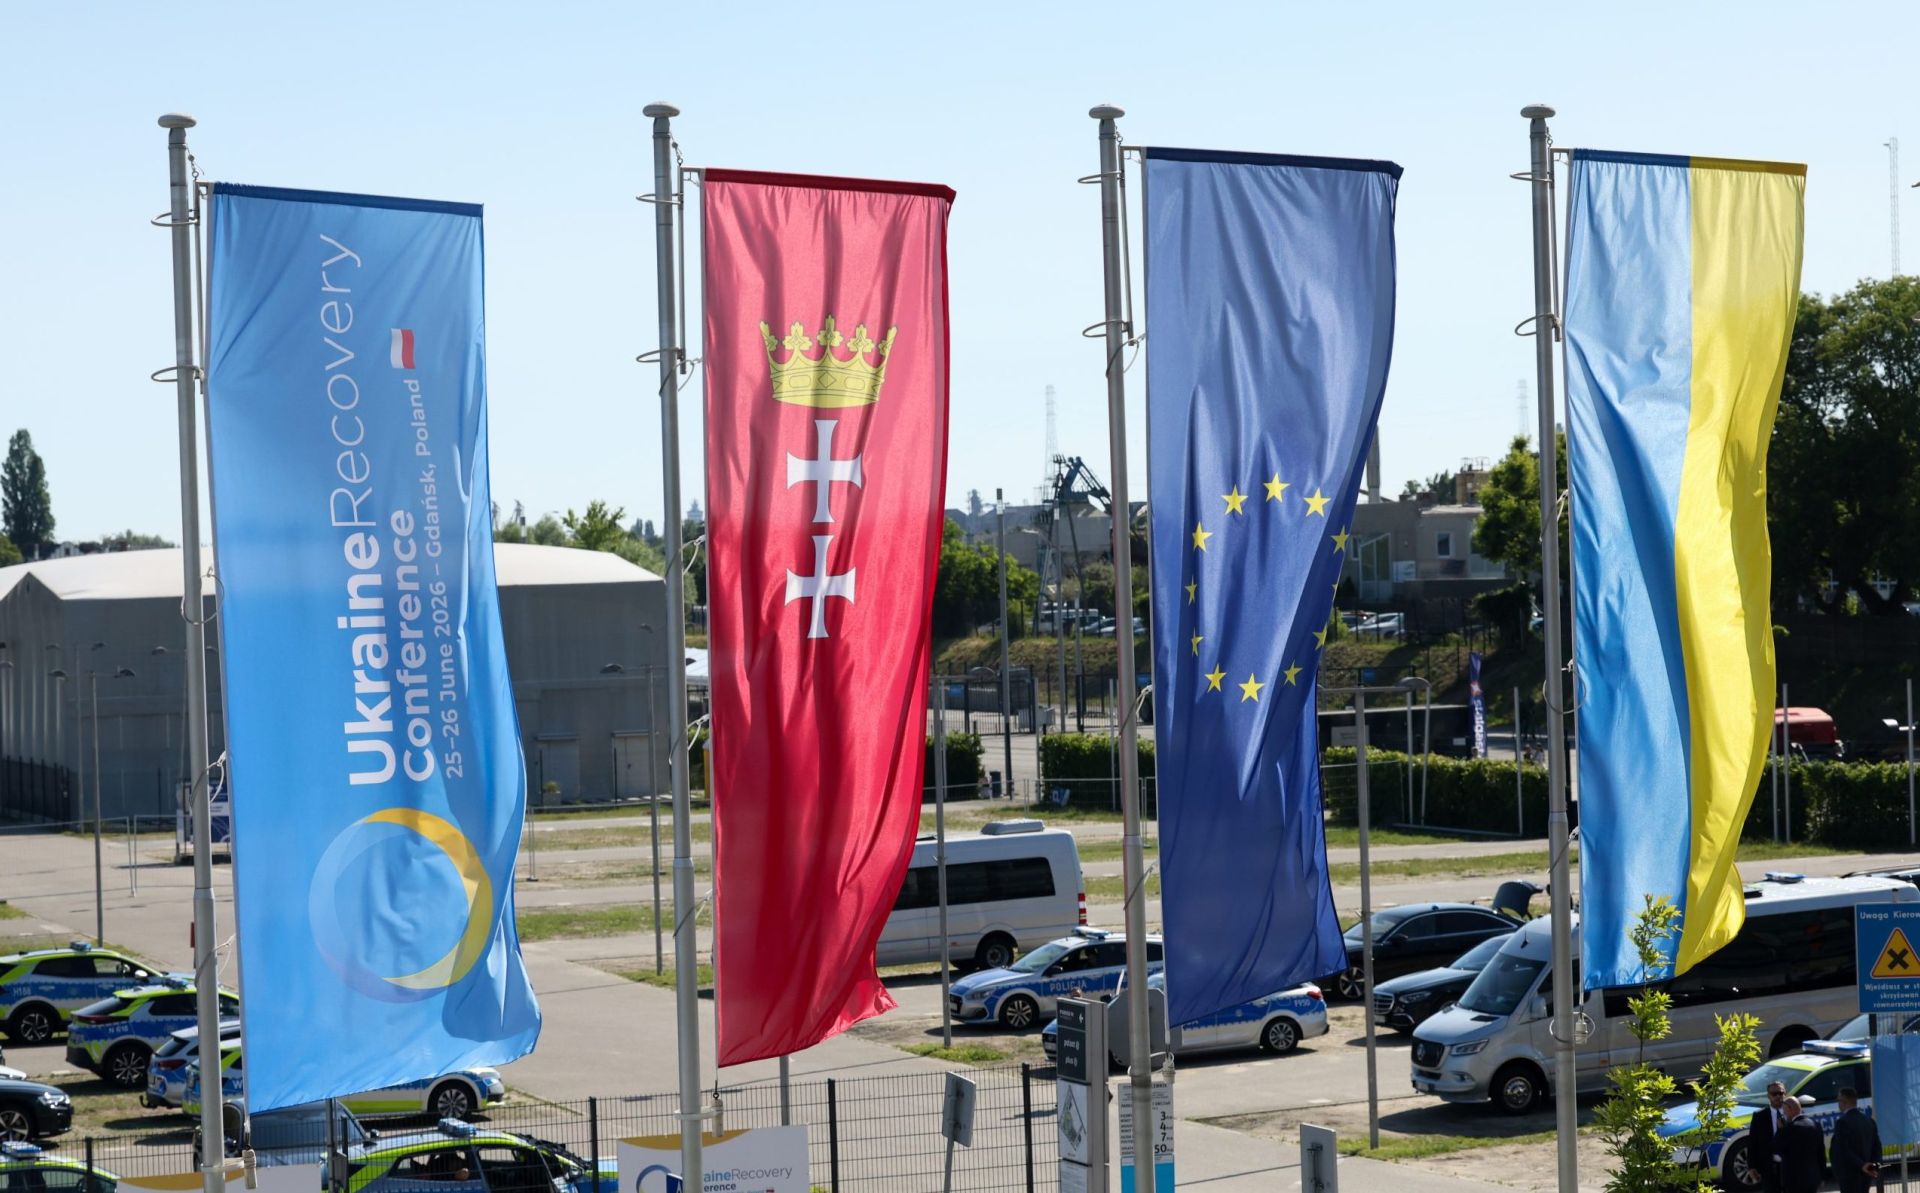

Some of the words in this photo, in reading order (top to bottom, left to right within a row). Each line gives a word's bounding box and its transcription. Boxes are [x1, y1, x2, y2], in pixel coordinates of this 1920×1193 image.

[403, 379, 431, 456] Poland
[320, 233, 396, 785] UkraineRecovery
[420, 463, 442, 557] Gdańsk,
[430, 581, 452, 638] 2026
[390, 510, 435, 782] Conference
[439, 644, 458, 702] June
[1860, 911, 1889, 921] Uwaga
[1160, 1111, 1166, 1121] 3
[1160, 1122, 1166, 1131] 4
[1161, 1132, 1167, 1142] 7
[1154, 1144, 1167, 1153] 50
[704, 1167, 793, 1182] aineRecovery
[704, 1183, 737, 1192] erence
